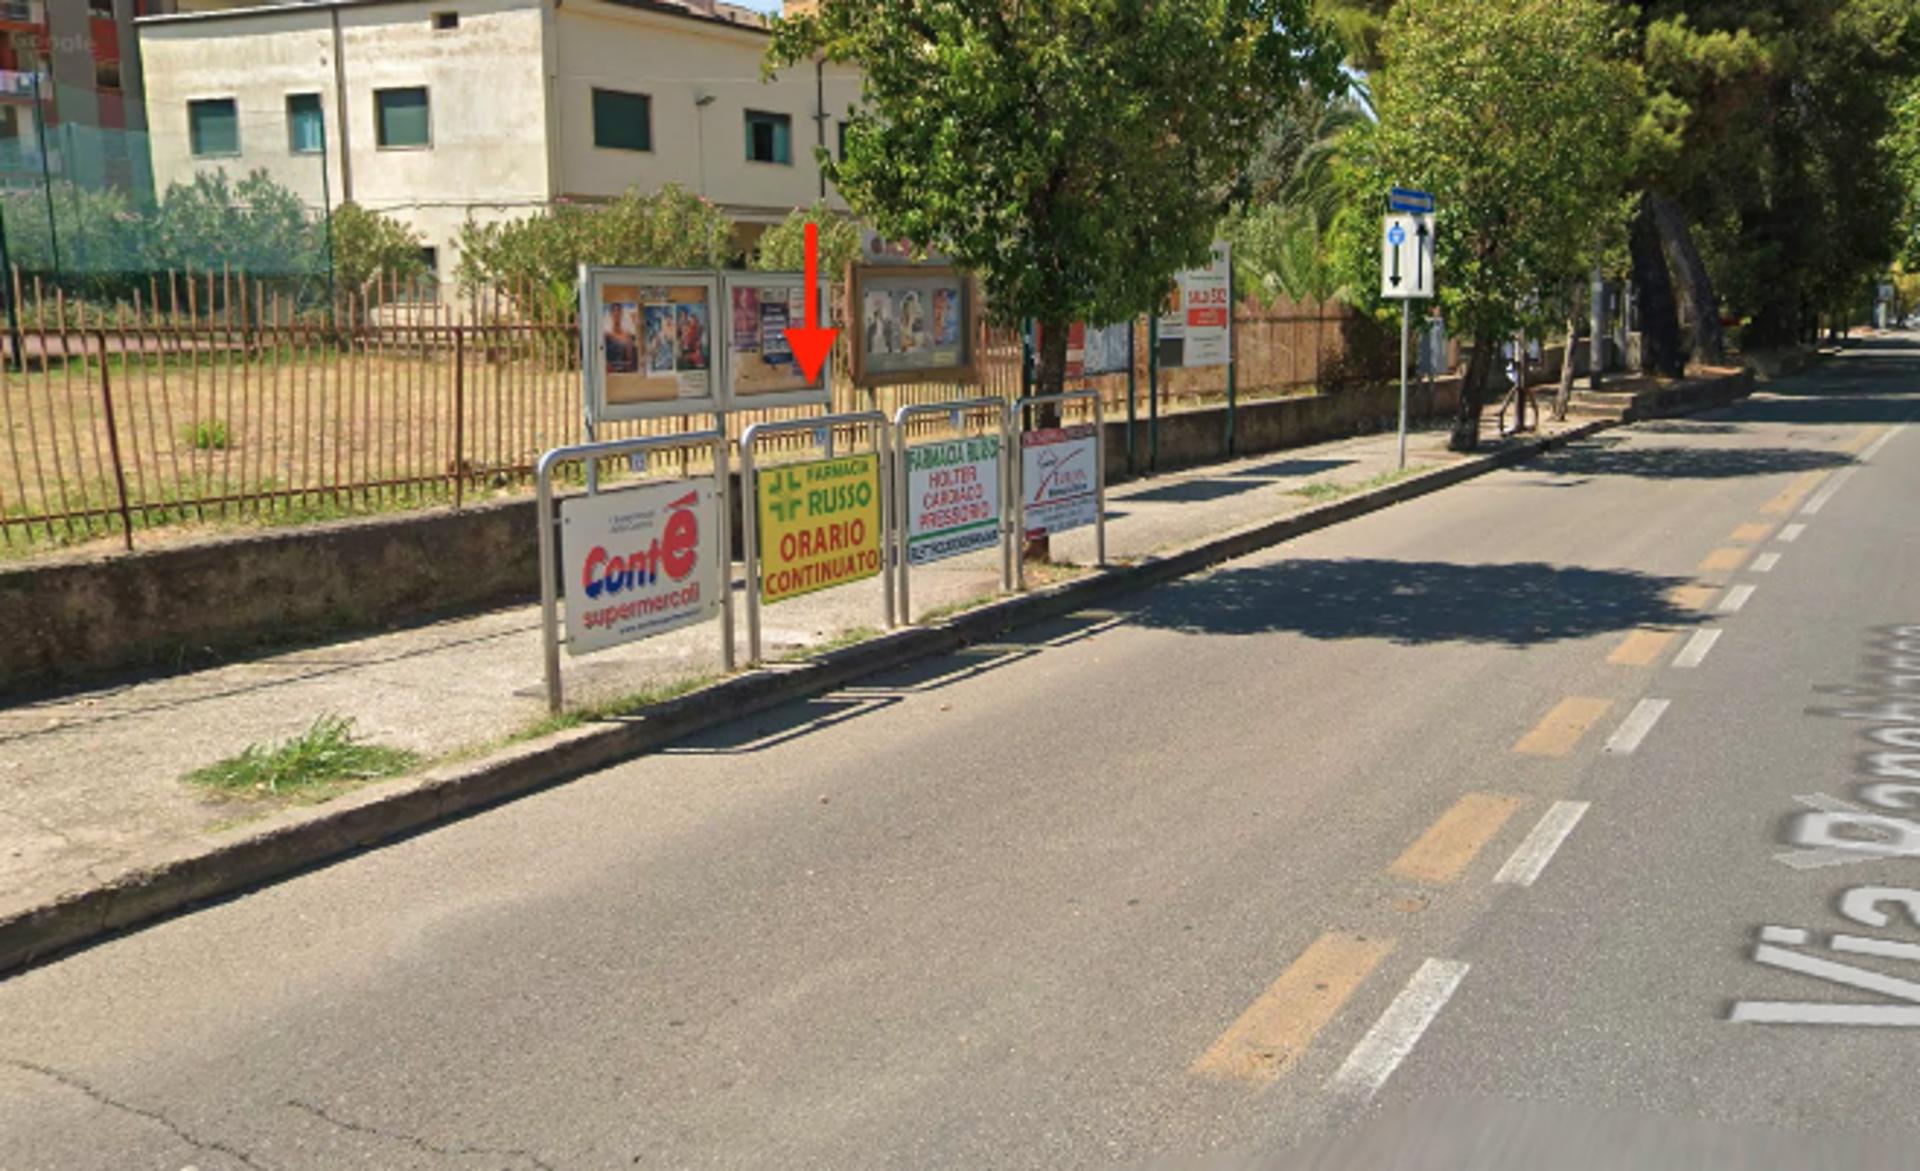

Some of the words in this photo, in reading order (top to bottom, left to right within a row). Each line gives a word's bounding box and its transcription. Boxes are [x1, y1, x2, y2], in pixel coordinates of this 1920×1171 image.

[806, 460, 869, 482] FARMACIA
[807, 480, 872, 517] RUSSO
[581, 489, 698, 599] Conté
[779, 517, 866, 563] ORARIO
[765, 548, 878, 596] CONTINUATO
[582, 582, 701, 630] supermercati
